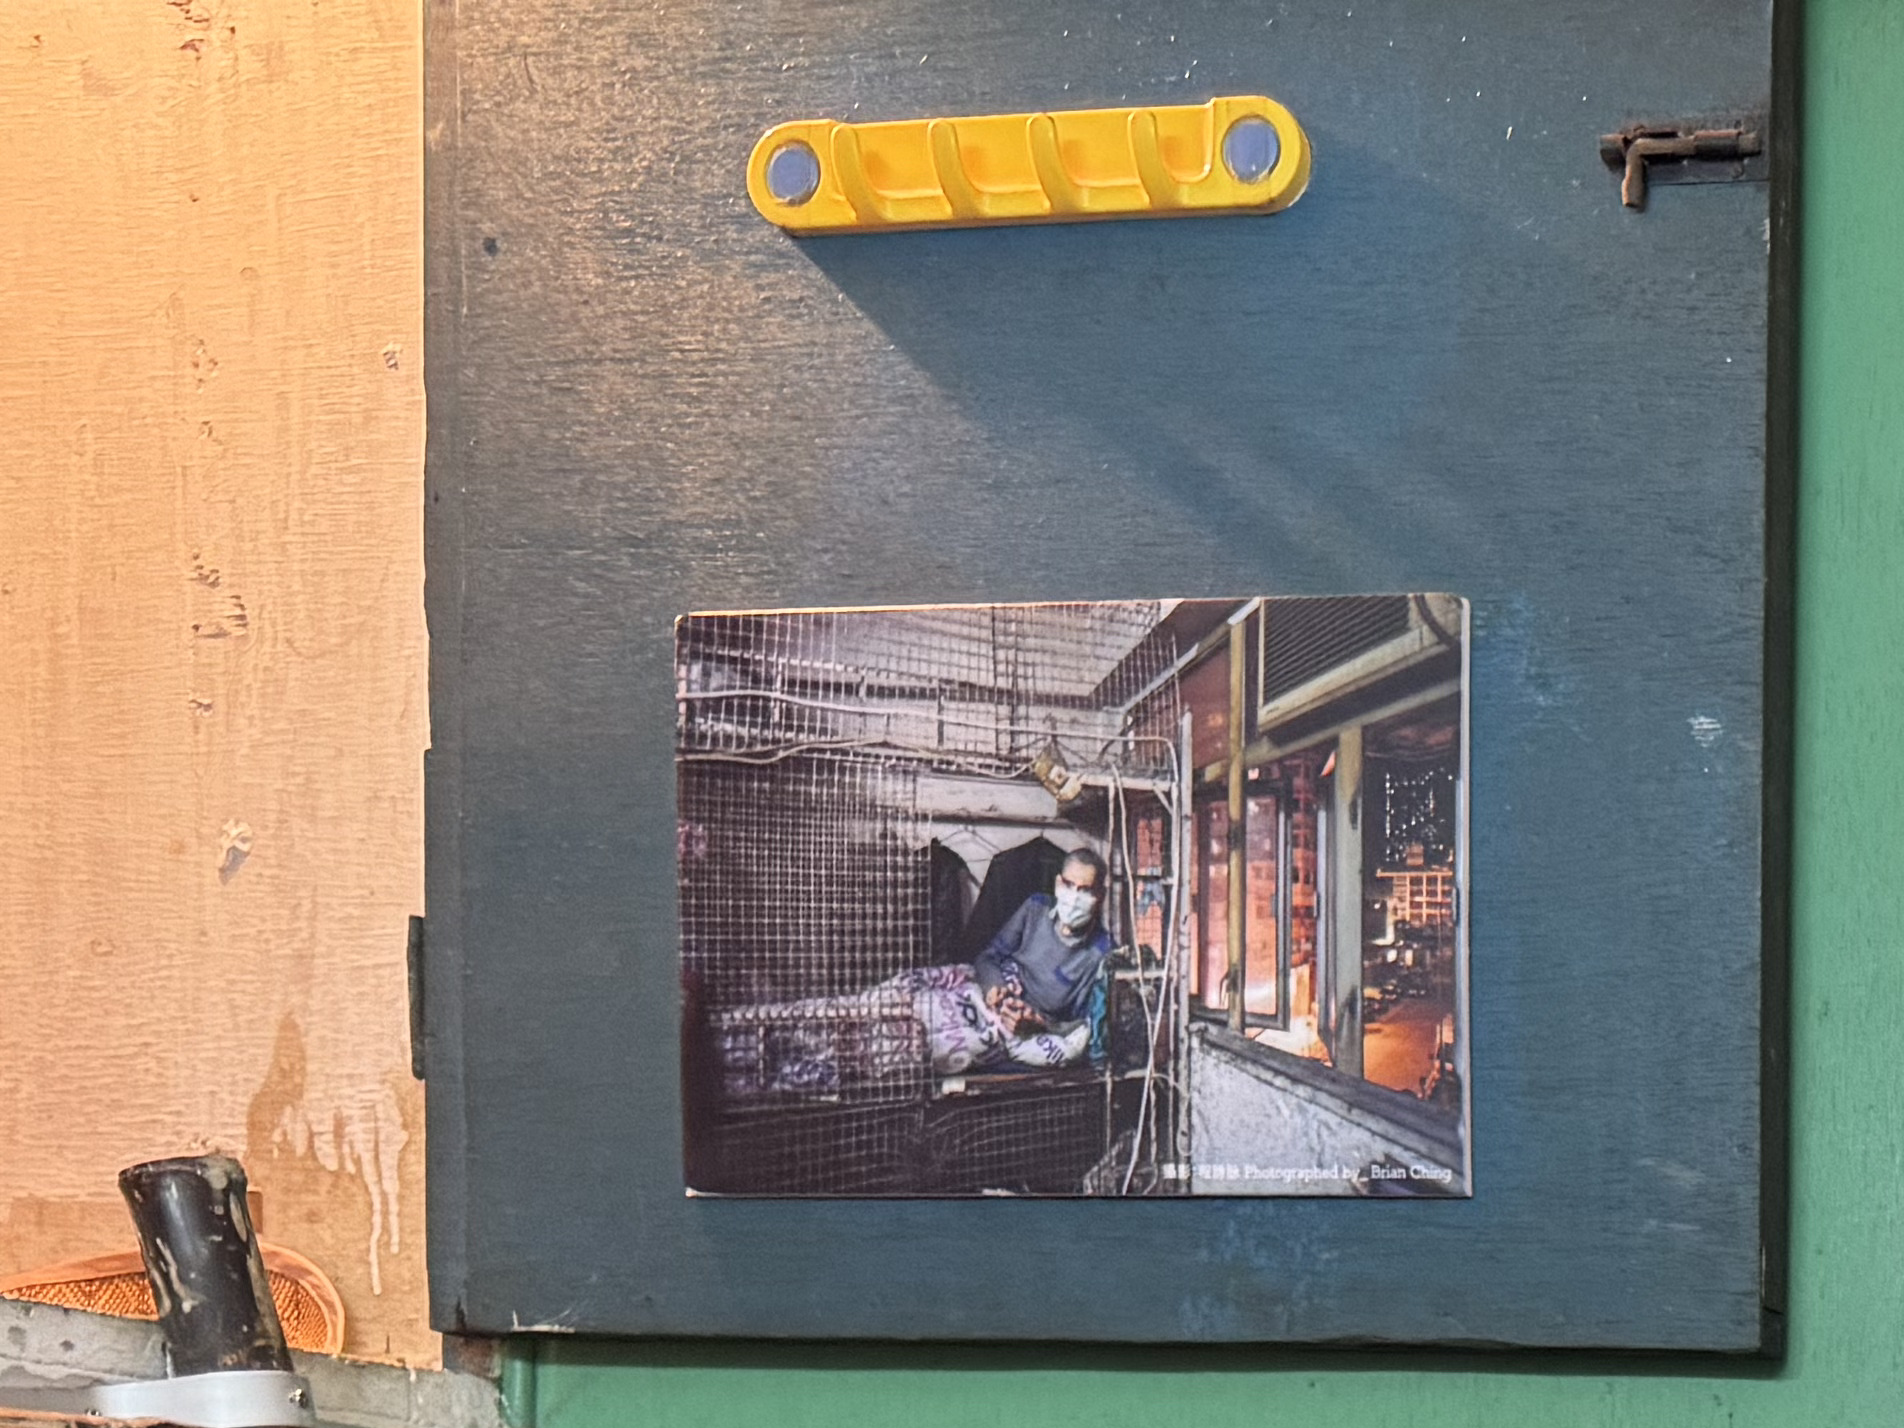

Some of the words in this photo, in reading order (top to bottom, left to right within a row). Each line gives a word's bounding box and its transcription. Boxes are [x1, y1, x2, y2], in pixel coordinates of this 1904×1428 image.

[1243, 1163, 1338, 1182] Photographed
[1370, 1164, 1407, 1180] Brian
[1409, 1164, 1453, 1183] Ching
